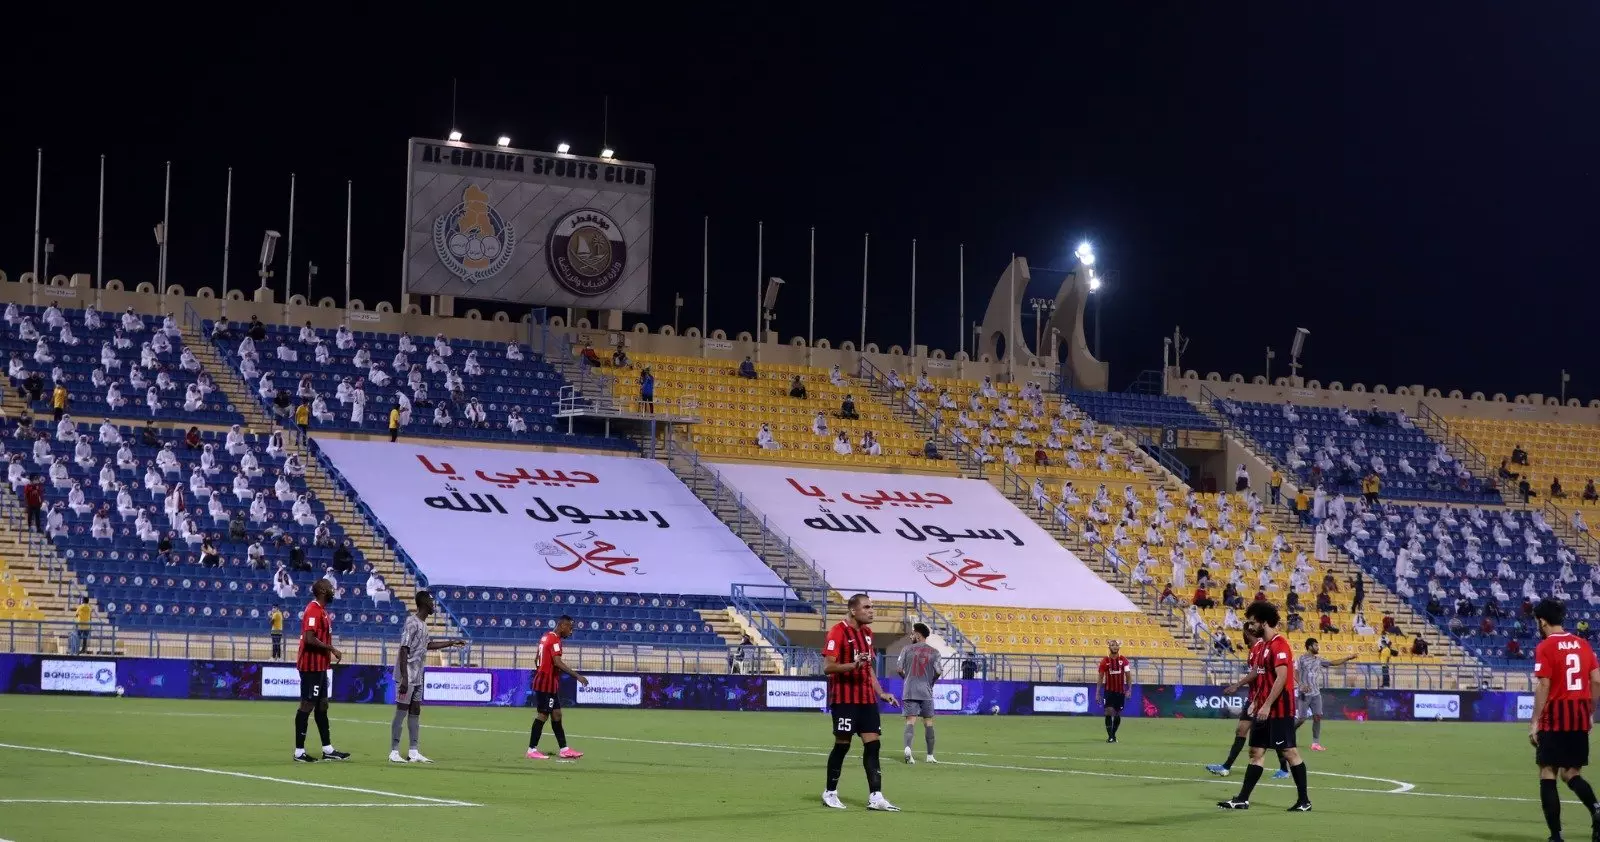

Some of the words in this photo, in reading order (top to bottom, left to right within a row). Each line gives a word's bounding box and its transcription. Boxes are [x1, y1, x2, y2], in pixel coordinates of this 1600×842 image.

[533, 157, 598, 180] SPORTS
[604, 166, 646, 185] CLUB
[1167, 429, 1174, 443] 8
[415, 454, 465, 481] يا
[474, 467, 600, 488] حبيبي
[423, 482, 509, 514] الله
[785, 477, 835, 503] يا
[841, 489, 954, 510] حبيبي
[525, 496, 670, 528] رسول
[803, 504, 882, 534] الله
[895, 517, 1025, 546] رسول
[51, 671, 70, 679] QNB
[1565, 653, 1582, 691] 2
[313, 685, 319, 696] 5
[1209, 696, 1243, 709] QNB
[837, 717, 852, 732] 25
